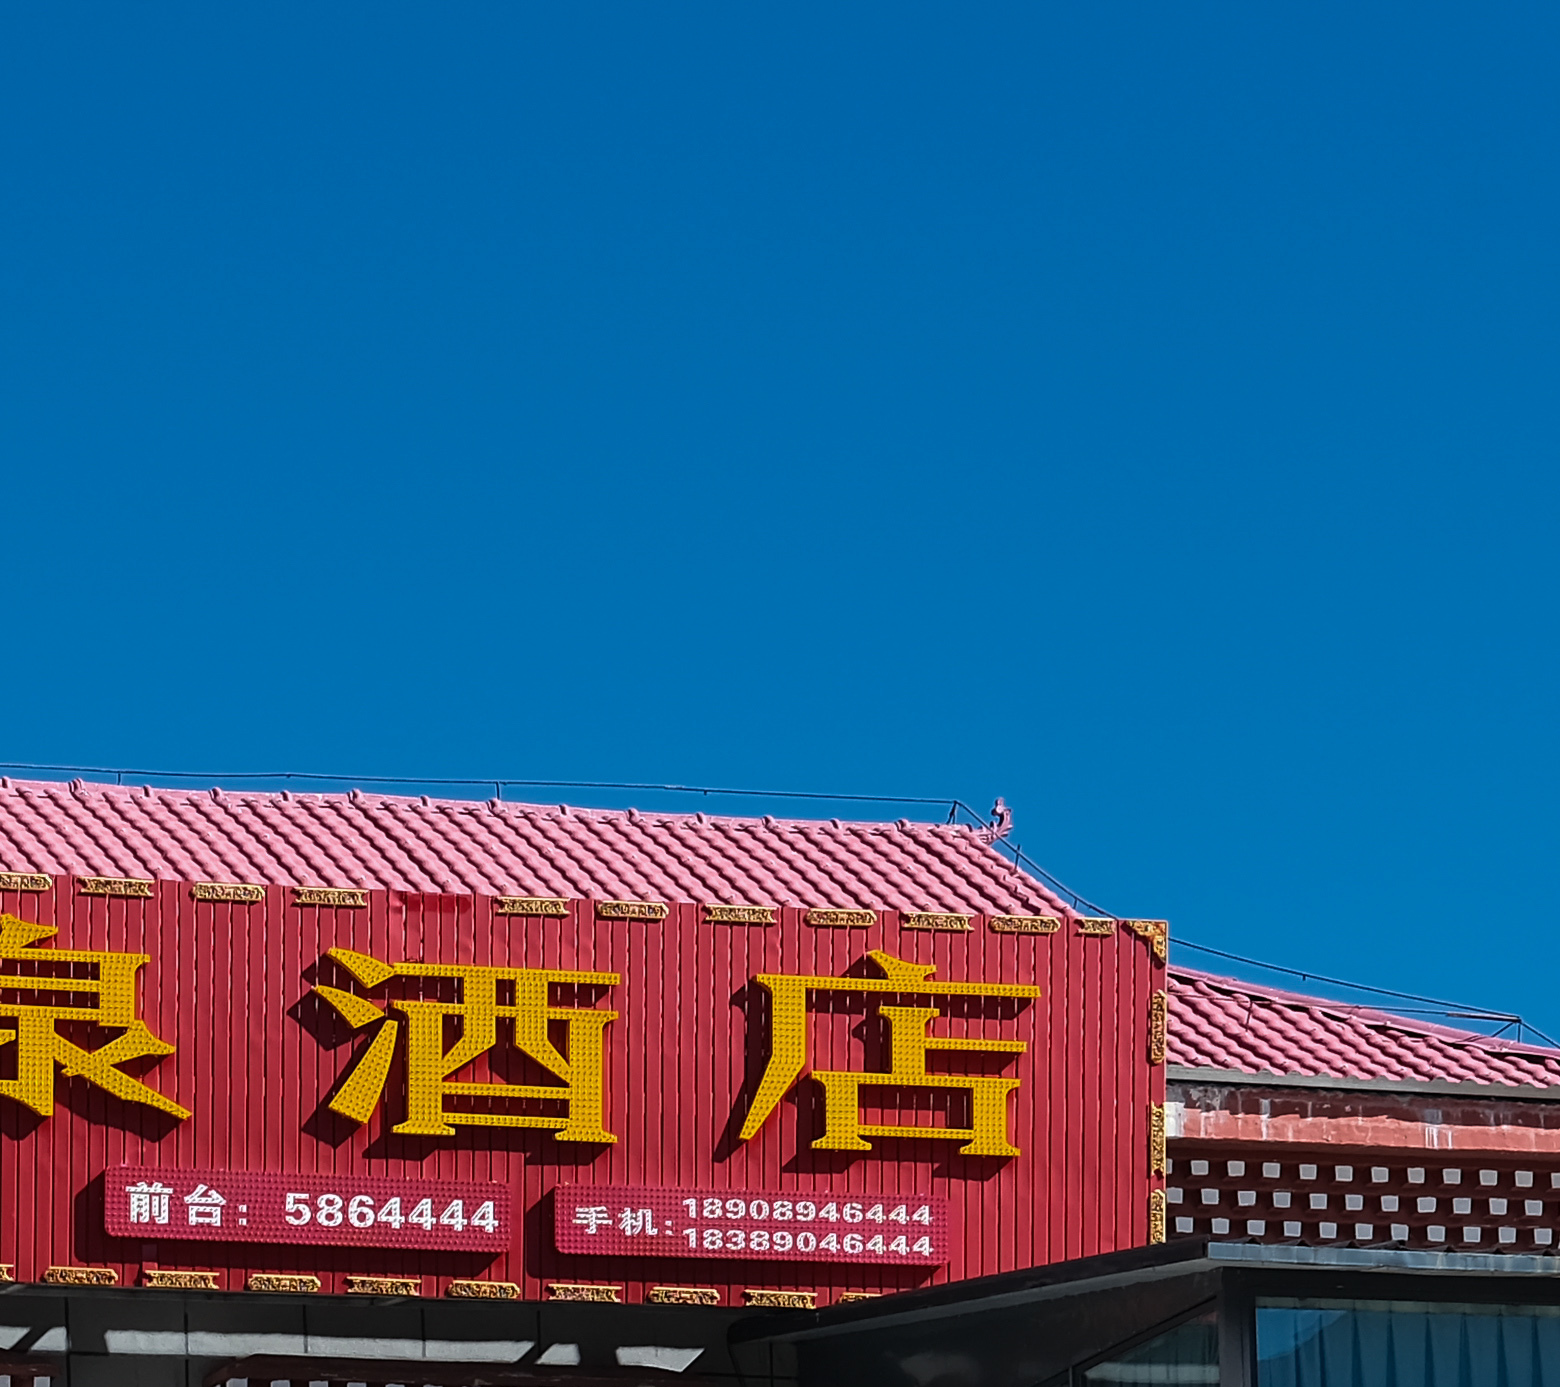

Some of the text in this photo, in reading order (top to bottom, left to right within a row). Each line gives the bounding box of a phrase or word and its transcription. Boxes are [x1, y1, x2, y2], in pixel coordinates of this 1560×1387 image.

[284, 1192, 501, 1235] 5864444
[681, 1197, 935, 1226] 18908946444
[681, 1227, 935, 1257] 18389046444
